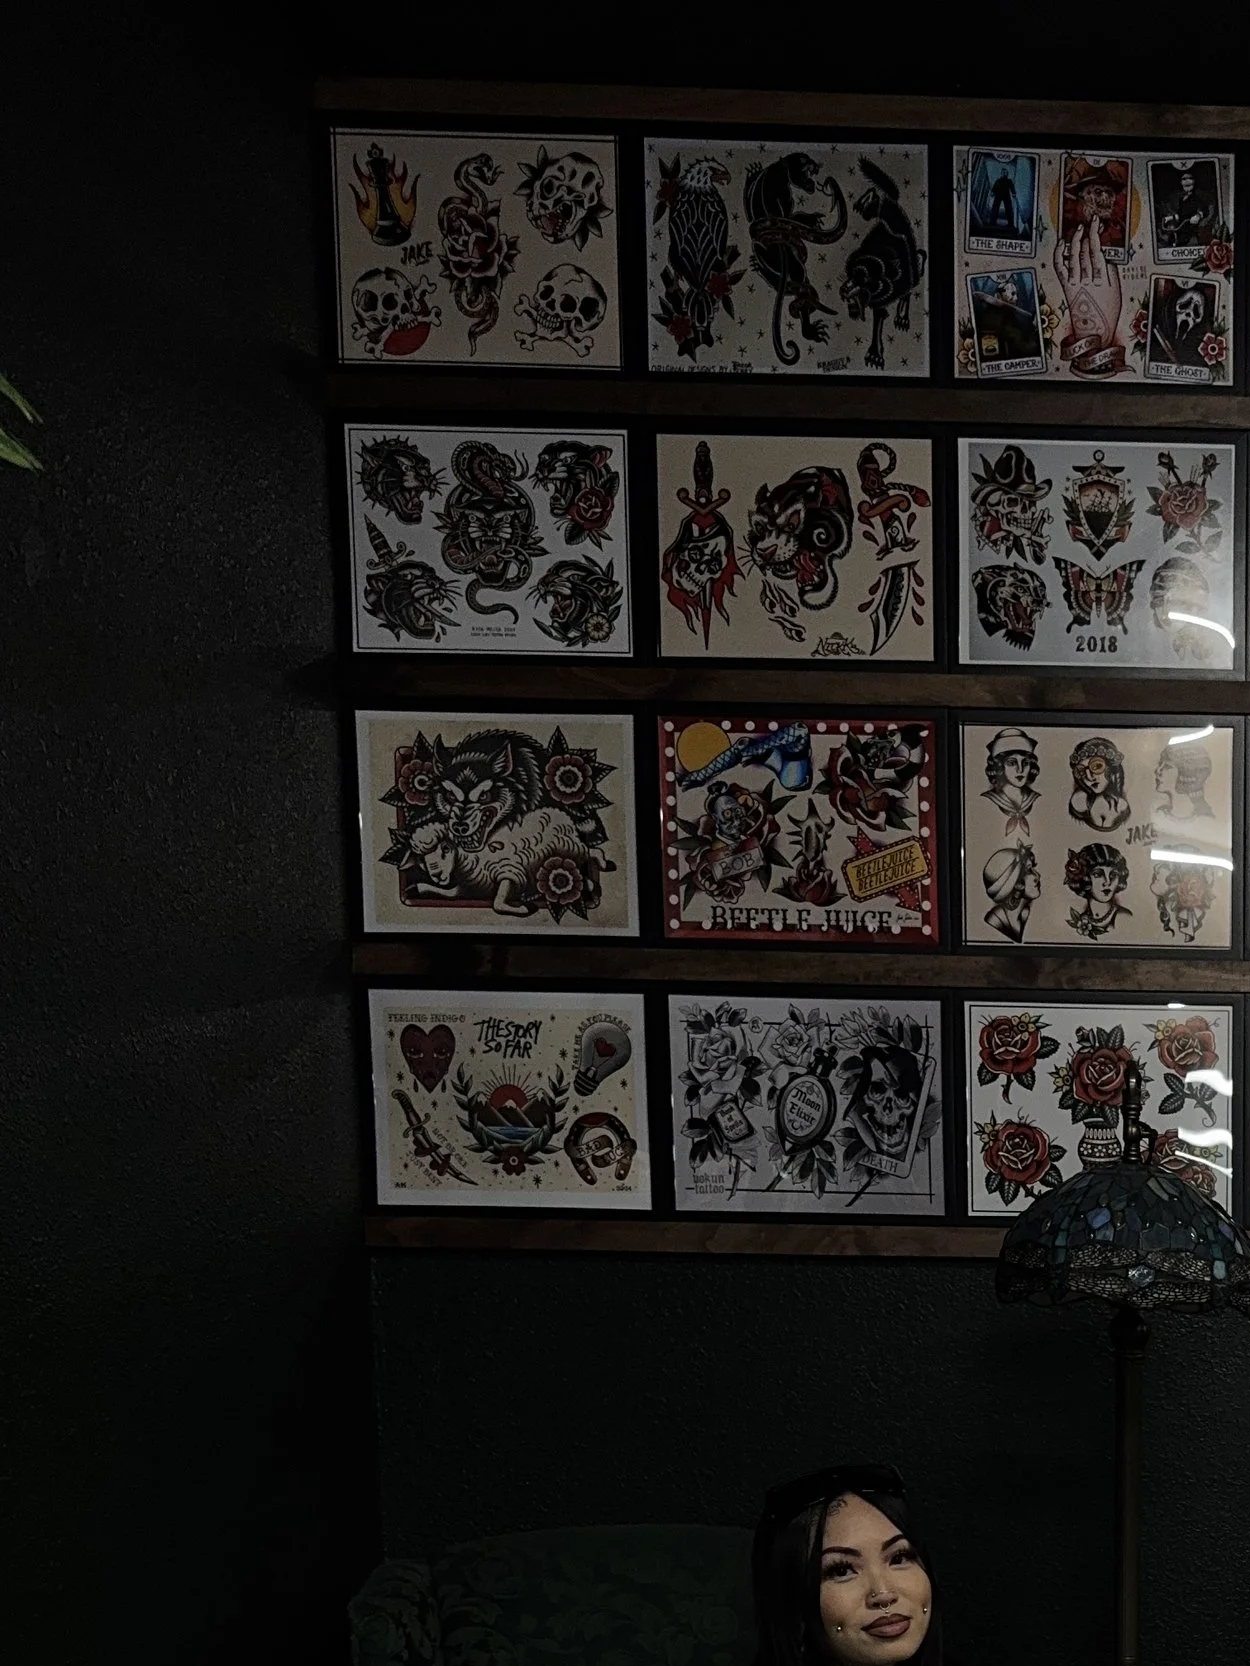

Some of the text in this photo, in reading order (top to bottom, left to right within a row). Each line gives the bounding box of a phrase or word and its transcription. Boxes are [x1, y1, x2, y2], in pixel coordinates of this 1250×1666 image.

[400, 241, 433, 265] JAKE
[975, 239, 1026, 251] THE SHAPE
[986, 360, 1039, 373] THE CAMPER
[1154, 364, 1204, 378] THE GHOST
[1076, 635, 1118, 653] 2018
[1125, 823, 1158, 845] JAKE
[720, 853, 755, 875] BOB
[856, 847, 915, 878] BEETLEJUICE
[858, 862, 917, 891] BEETLEJUICE
[825, 909, 892, 932] JUICE
[430, 1013, 466, 1023] INDIGO
[473, 1017, 542, 1044] THE STORY
[482, 1039, 532, 1058] SO FAR
[791, 1086, 821, 1112] Moon
[790, 1101, 816, 1126] Elixir
[576, 1140, 601, 1157] BAD
[862, 1153, 898, 1173] DEATH
[694, 1184, 725, 1195] tattoo
